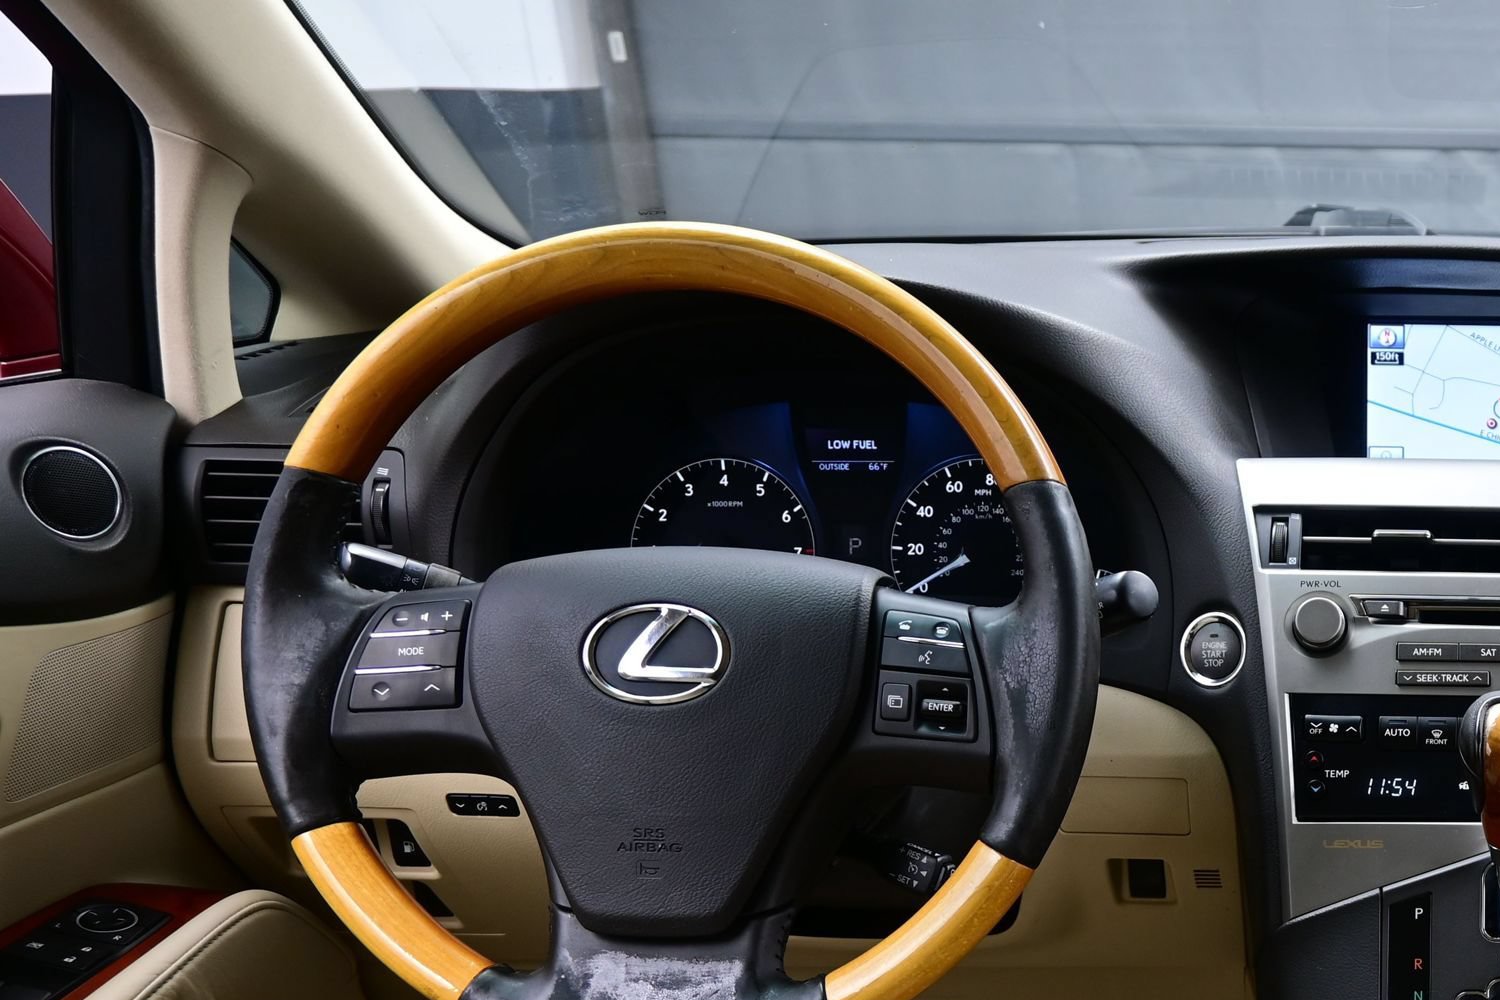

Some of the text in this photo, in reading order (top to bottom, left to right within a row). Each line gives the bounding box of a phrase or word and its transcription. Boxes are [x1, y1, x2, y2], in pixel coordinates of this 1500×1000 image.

[1469, 332, 1493, 347] APPLE
[1375, 352, 1400, 360] 150ft
[828, 440, 878, 450] LOW FUEL
[818, 463, 850, 471] OUTSIDE
[720, 474, 728, 486] 4
[684, 484, 694, 497] 3
[756, 484, 766, 497] 5
[946, 480, 963, 493] 60
[658, 509, 668, 522] 2
[782, 510, 792, 523] 6
[916, 506, 934, 518] 40
[962, 508, 974, 516] 100
[952, 516, 962, 524] 80
[942, 528, 952, 536] 60
[849, 538, 862, 555] P
[907, 543, 924, 556] 20
[398, 646, 424, 656] MODE
[1202, 650, 1226, 658] START
[1480, 648, 1497, 658] SAT
[1204, 658, 1224, 667] STOP
[928, 702, 954, 712] ENTER
[1384, 728, 1411, 738] AUTO
[1425, 738, 1448, 746] FRONT
[1324, 769, 1350, 778] TEMP
[1366, 778, 1418, 797] 11:54
[632, 828, 665, 838] SRS
[616, 841, 682, 852] AIRBAG
[1322, 840, 1385, 849] LEXUS
[896, 874, 911, 886] SET
[1414, 908, 1424, 920] P
[1414, 958, 1423, 970] R
